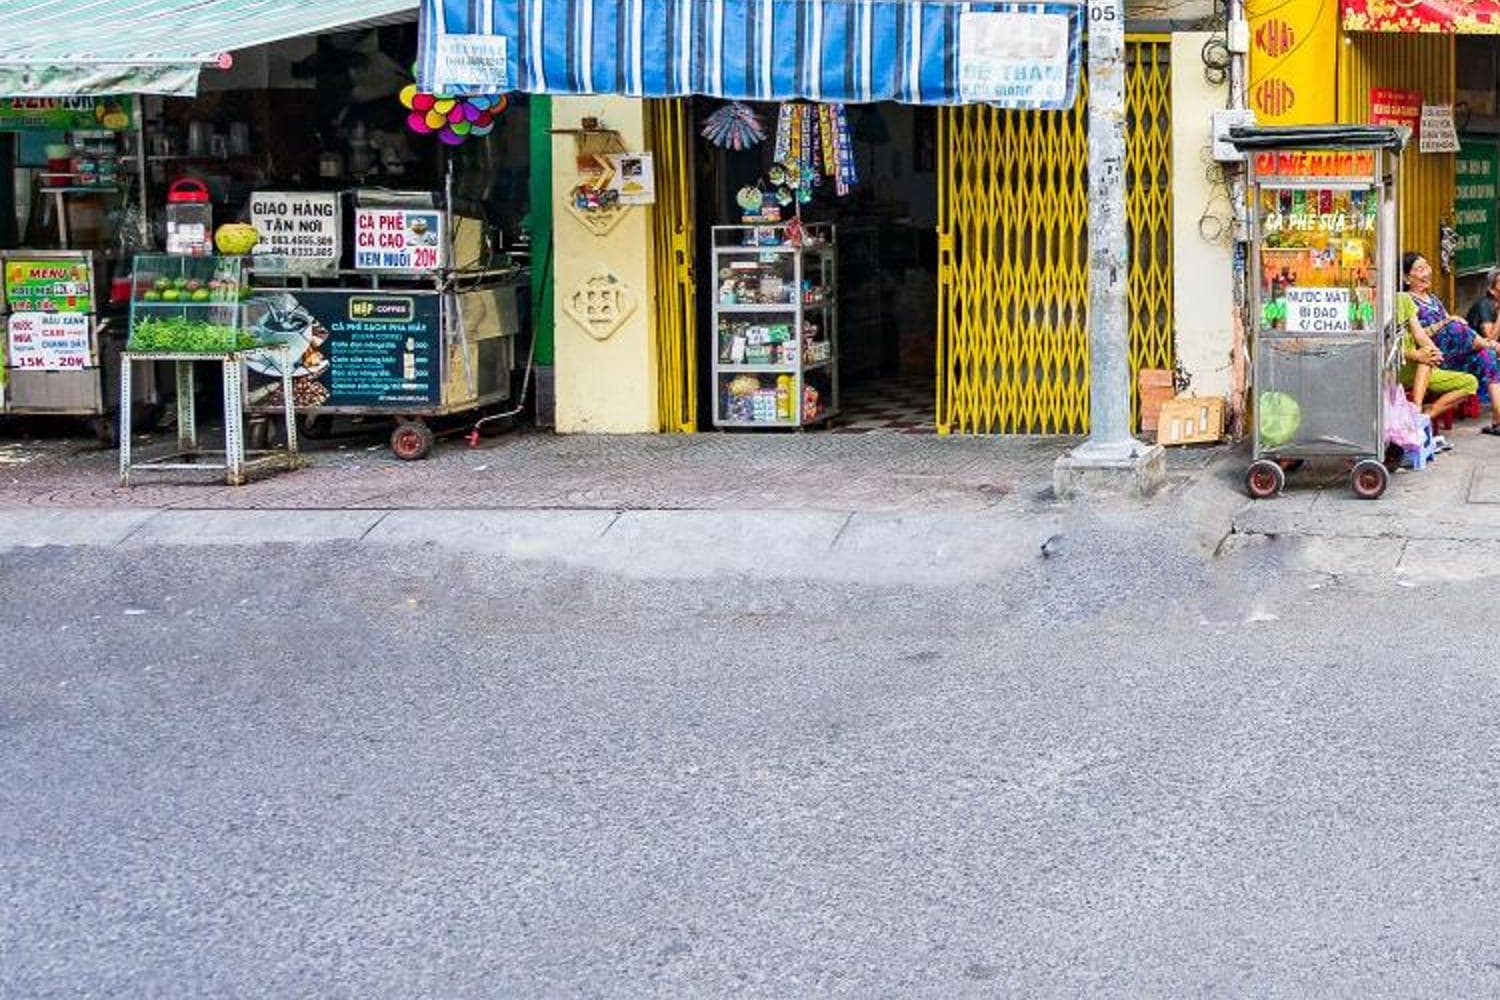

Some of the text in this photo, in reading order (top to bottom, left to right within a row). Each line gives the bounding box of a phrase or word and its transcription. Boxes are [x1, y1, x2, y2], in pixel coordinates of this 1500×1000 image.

[1091, 6, 1115, 22] 05
[254, 200, 333, 217] GIAO HÀNG
[1313, 319, 1348, 331] CHAI
[19, 357, 45, 367] 15K
[59, 357, 85, 367] 20K
